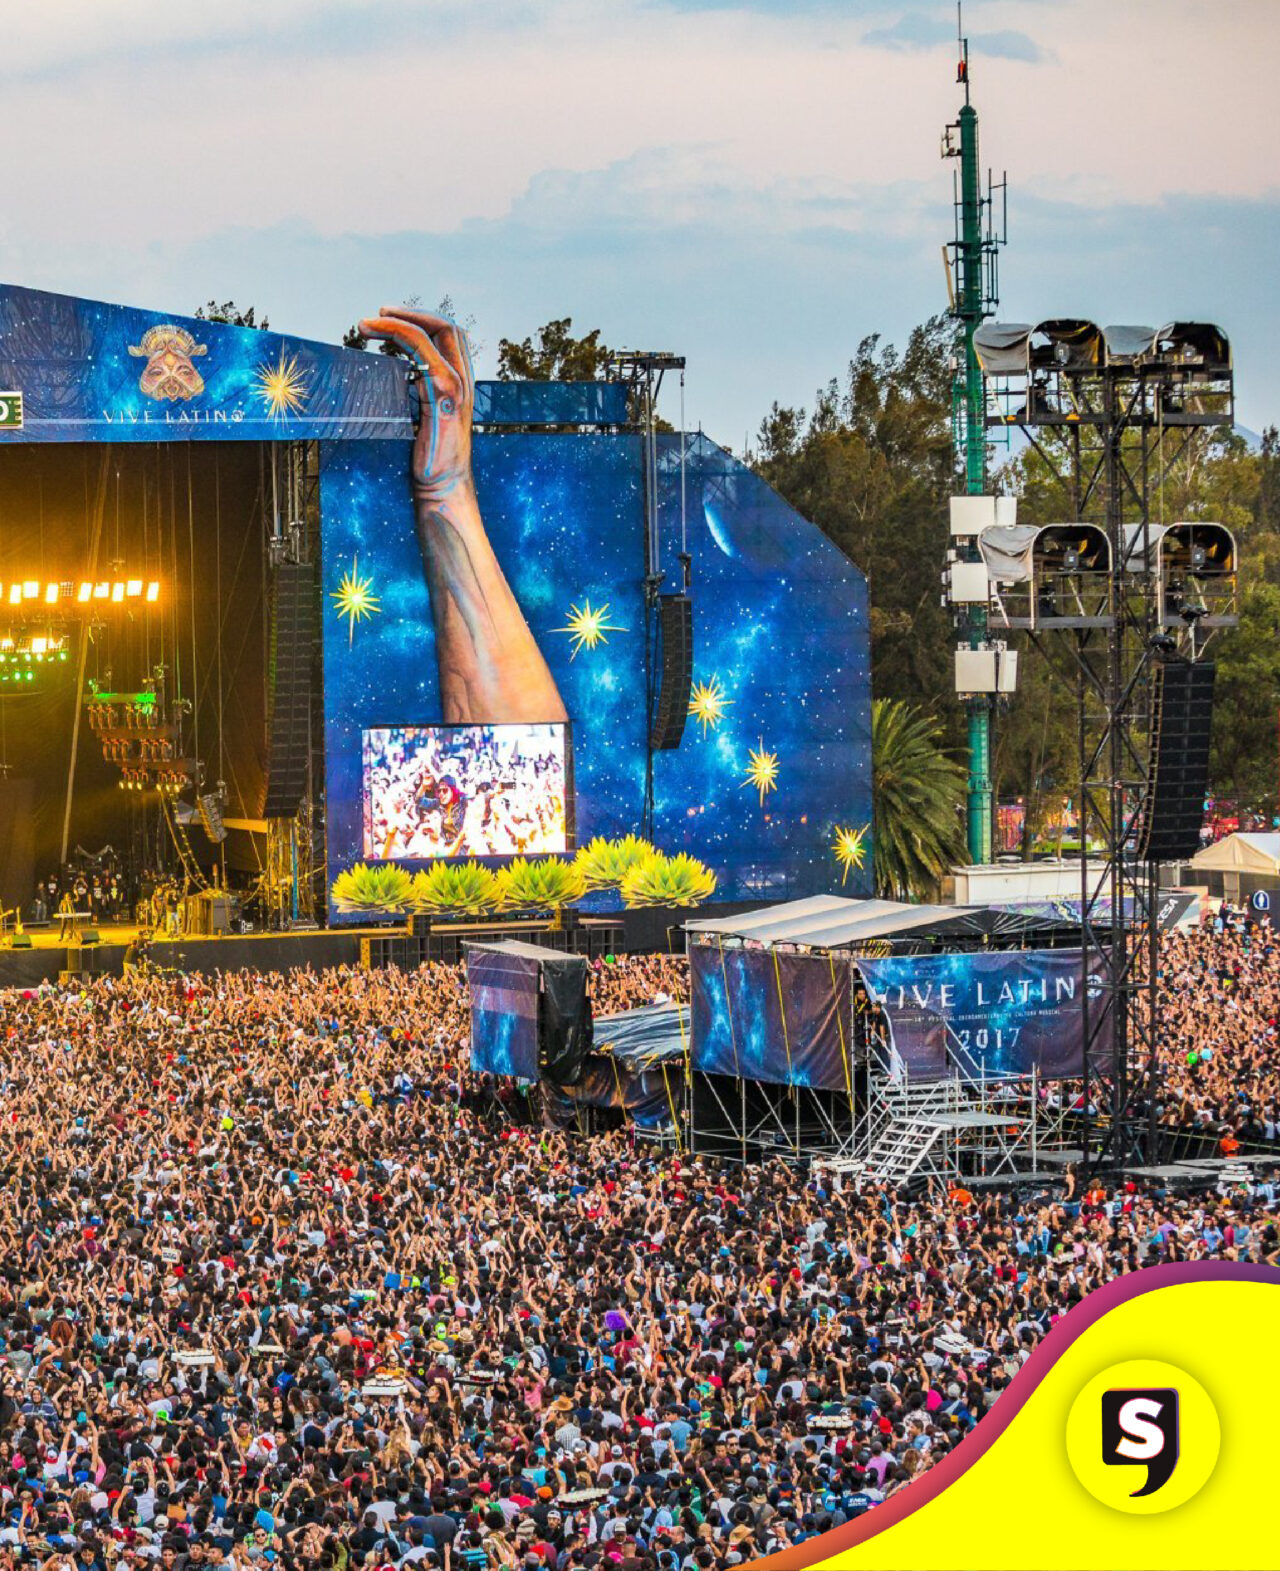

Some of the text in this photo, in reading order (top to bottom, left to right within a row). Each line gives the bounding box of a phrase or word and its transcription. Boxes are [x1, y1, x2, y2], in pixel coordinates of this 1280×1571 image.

[102, 409, 245, 424] VIVE LATINO
[959, 1027, 1020, 1051] 2017
